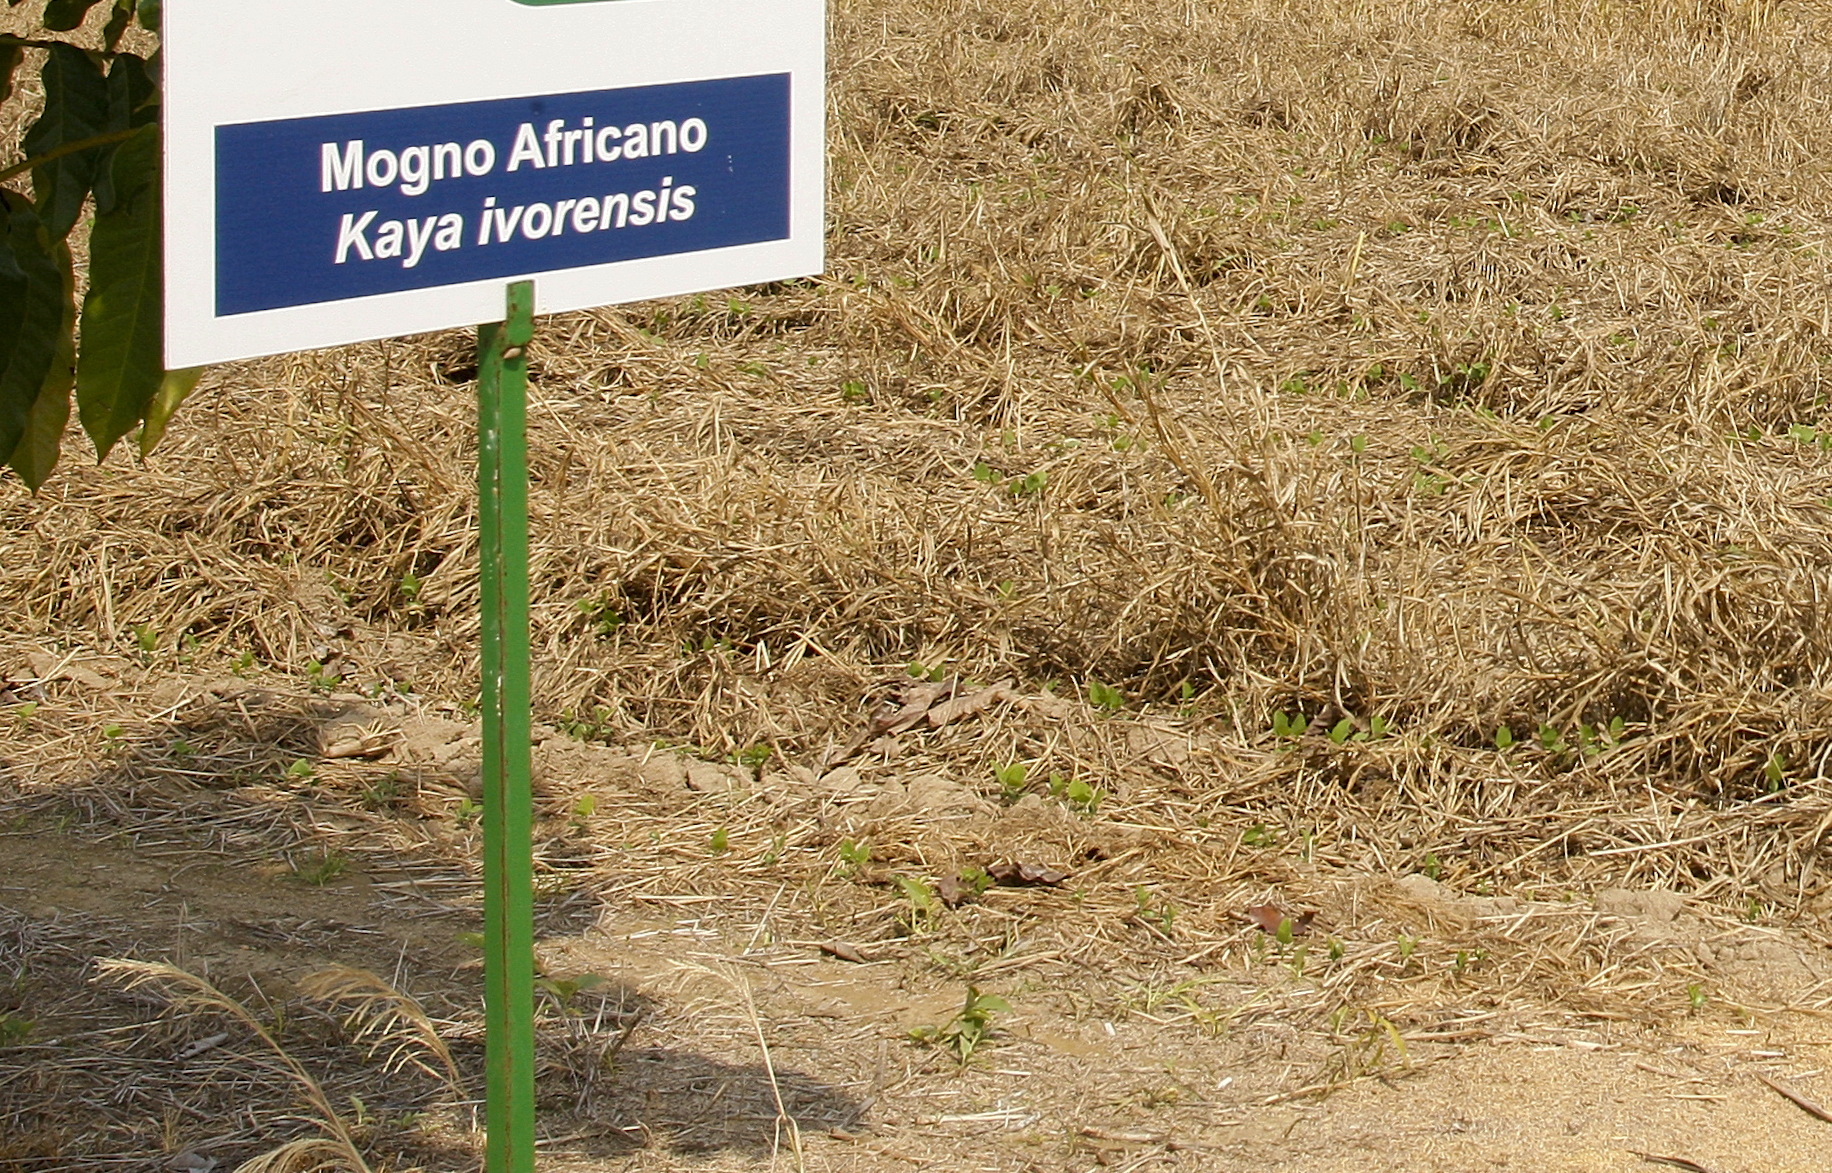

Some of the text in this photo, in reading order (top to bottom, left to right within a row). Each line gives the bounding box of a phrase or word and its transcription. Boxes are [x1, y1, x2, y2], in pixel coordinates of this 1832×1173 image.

[320, 116, 708, 197] Mogno Africano
[334, 176, 697, 268] Kaya ivorensis
